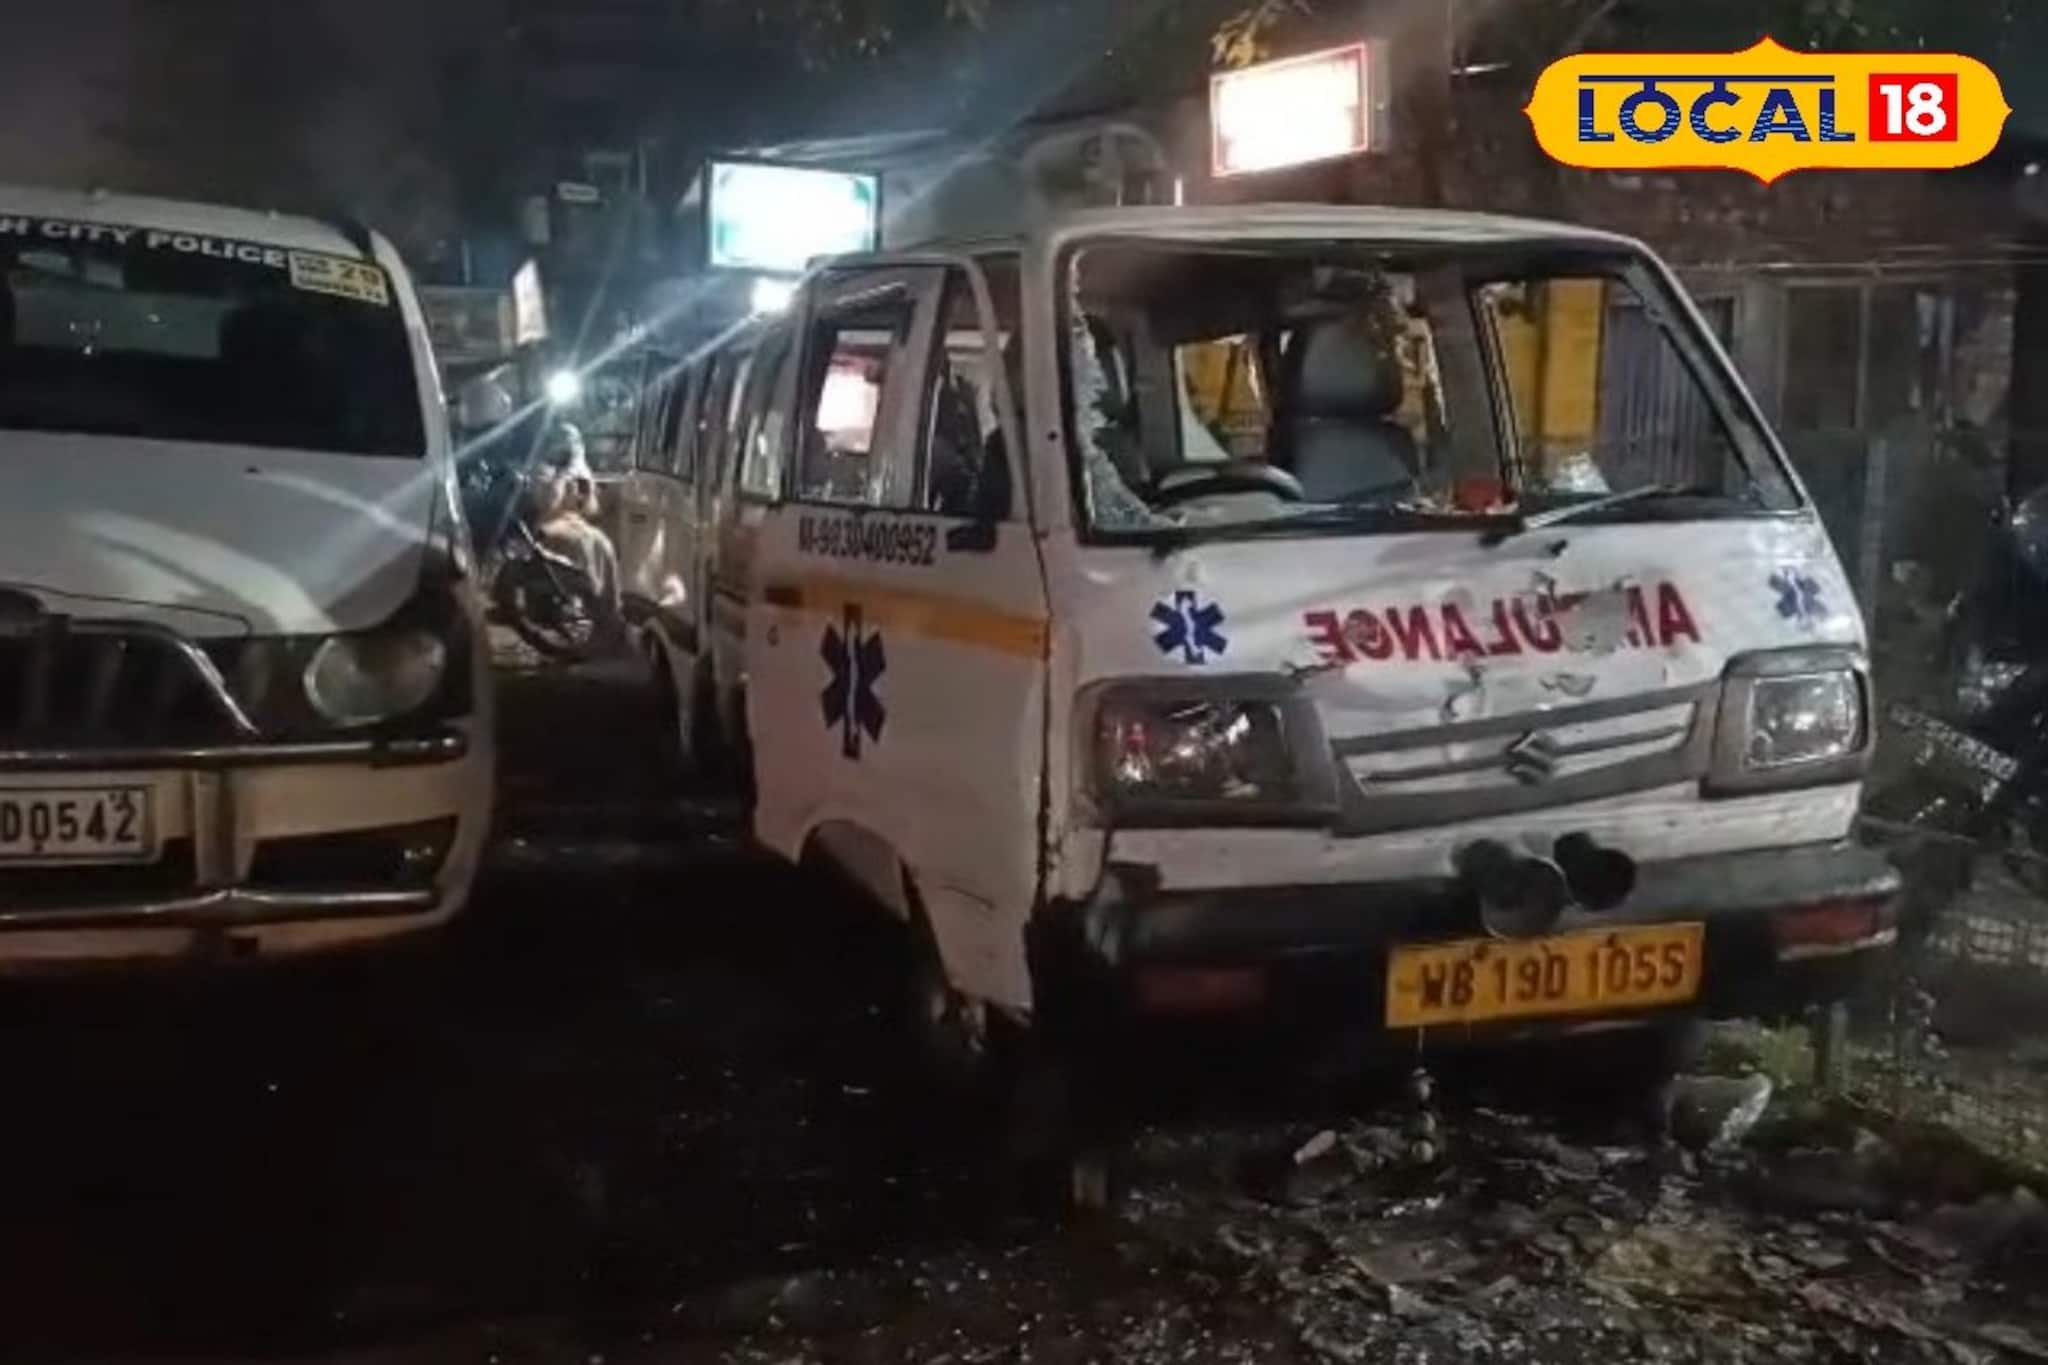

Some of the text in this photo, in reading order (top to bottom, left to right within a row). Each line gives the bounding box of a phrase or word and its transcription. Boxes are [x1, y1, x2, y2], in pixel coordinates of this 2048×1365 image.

[41, 218, 136, 244] CITY
[147, 233, 289, 267] POLICE
[1419, 943, 1687, 1009] WB 19D 1055
